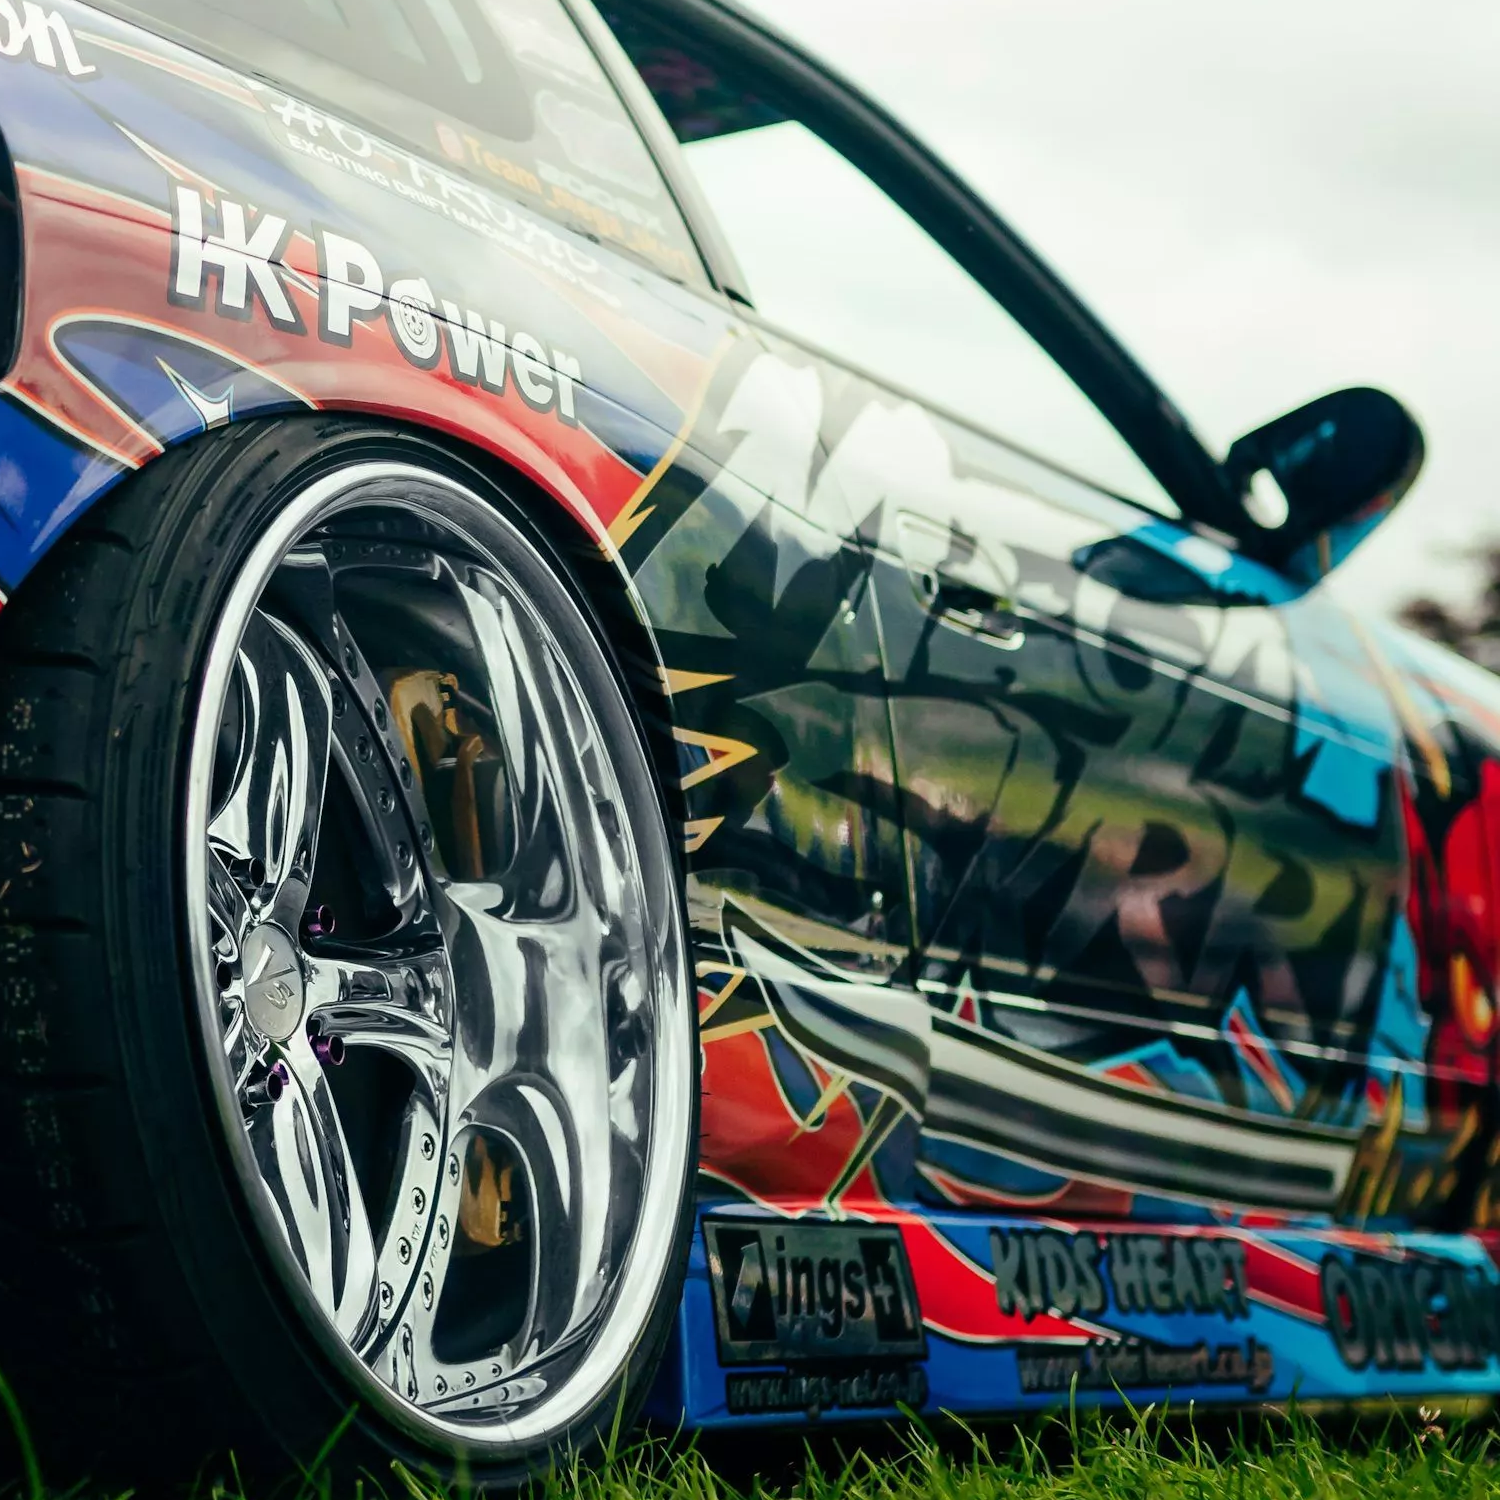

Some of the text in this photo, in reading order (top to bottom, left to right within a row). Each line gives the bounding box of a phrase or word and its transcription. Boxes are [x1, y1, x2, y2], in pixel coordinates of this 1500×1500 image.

[286, 132, 389, 187] EXCITING
[989, 1230, 1246, 1319] KIDS HEART
